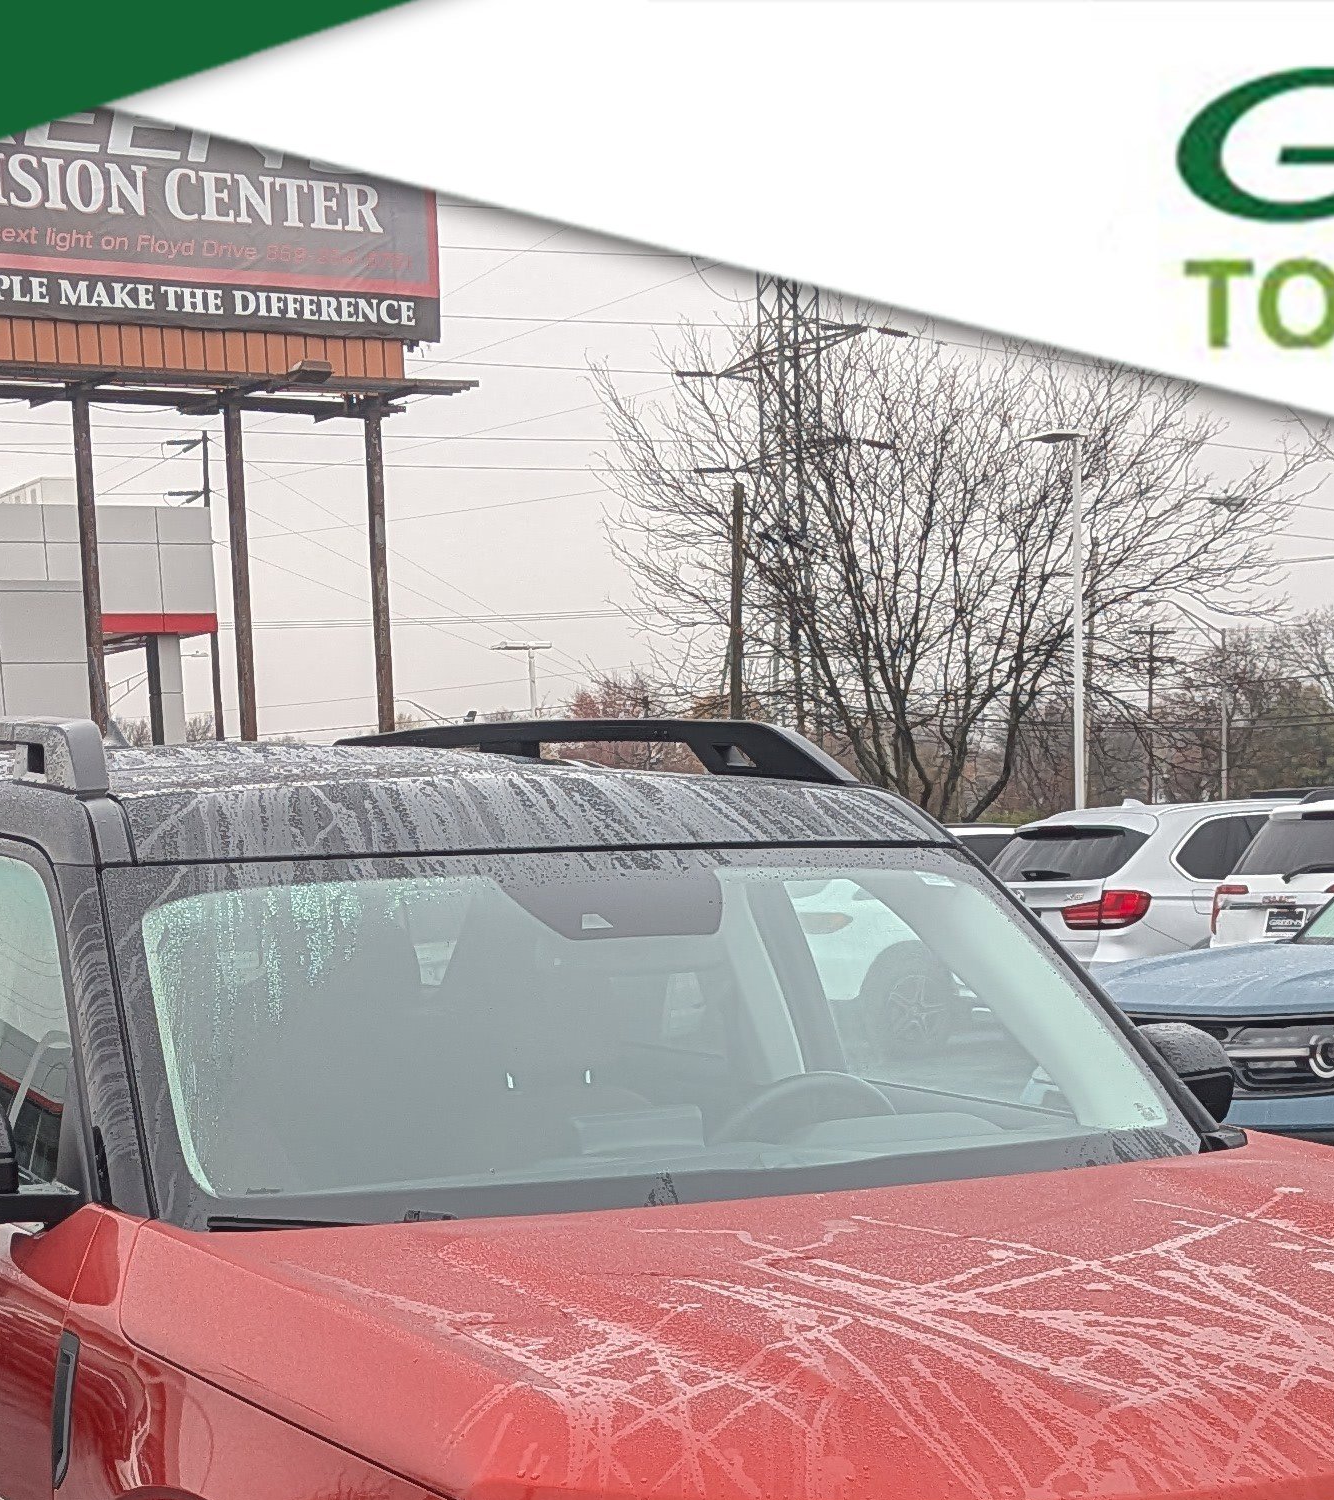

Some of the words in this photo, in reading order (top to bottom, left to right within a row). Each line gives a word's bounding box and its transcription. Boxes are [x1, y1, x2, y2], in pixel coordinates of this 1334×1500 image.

[164, 167, 385, 234] CENTER
[45, 226, 93, 251] light
[101, 235, 129, 251] on
[136, 234, 195, 260] Floyd
[203, 240, 257, 262] Drive
[57, 278, 156, 310] MAKE
[160, 285, 224, 316] THE
[232, 289, 417, 327] DIFFERENCE
